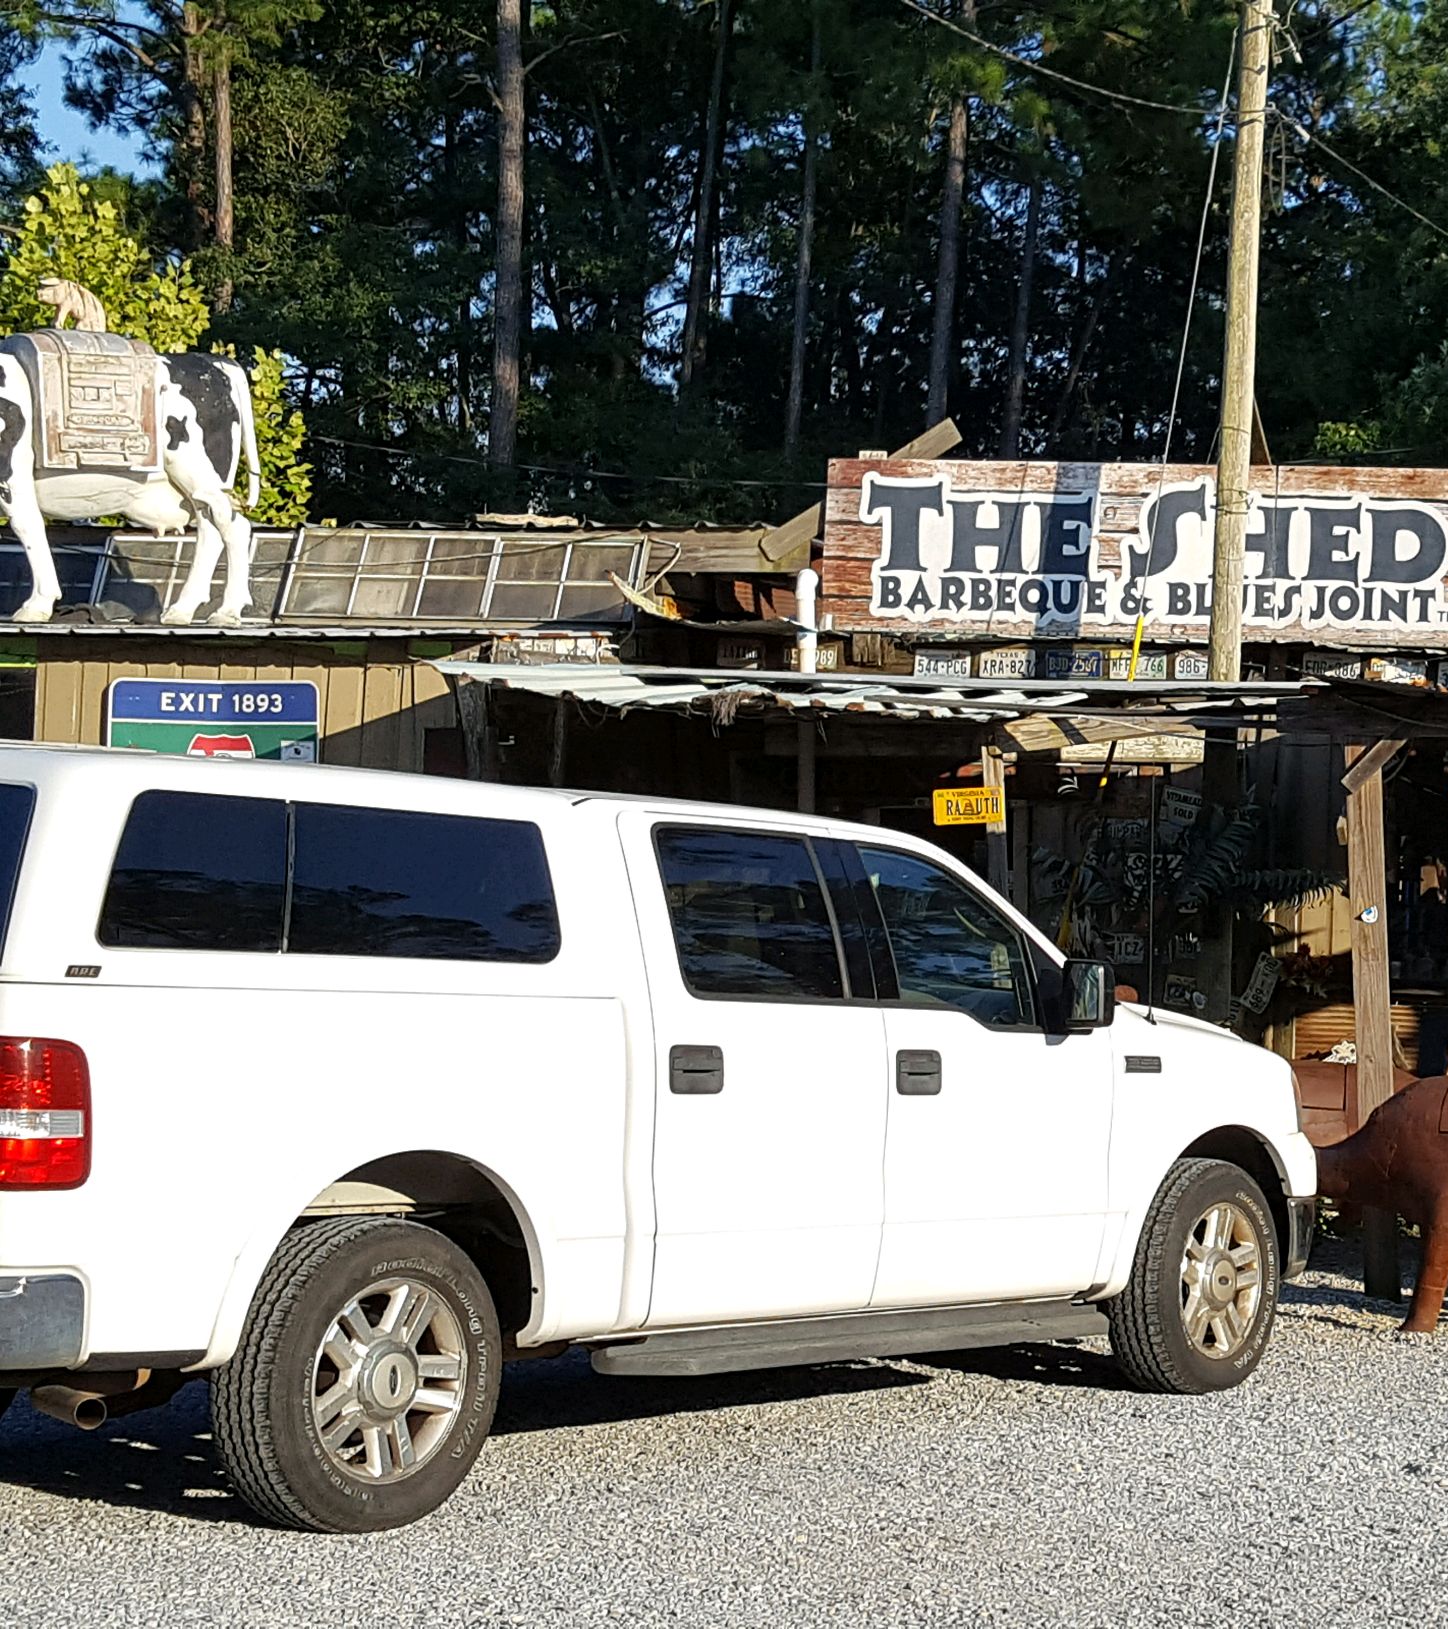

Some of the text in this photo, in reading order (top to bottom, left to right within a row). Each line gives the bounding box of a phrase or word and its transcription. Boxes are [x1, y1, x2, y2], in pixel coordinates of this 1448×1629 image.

[867, 479, 1446, 587] THE SHED
[878, 575, 1106, 617] BARBEQUE
[1120, 575, 1154, 617] &
[1166, 582, 1302, 621] BLES
[1309, 585, 1437, 623] JOINT
[160, 692, 283, 713] EXIT 1893
